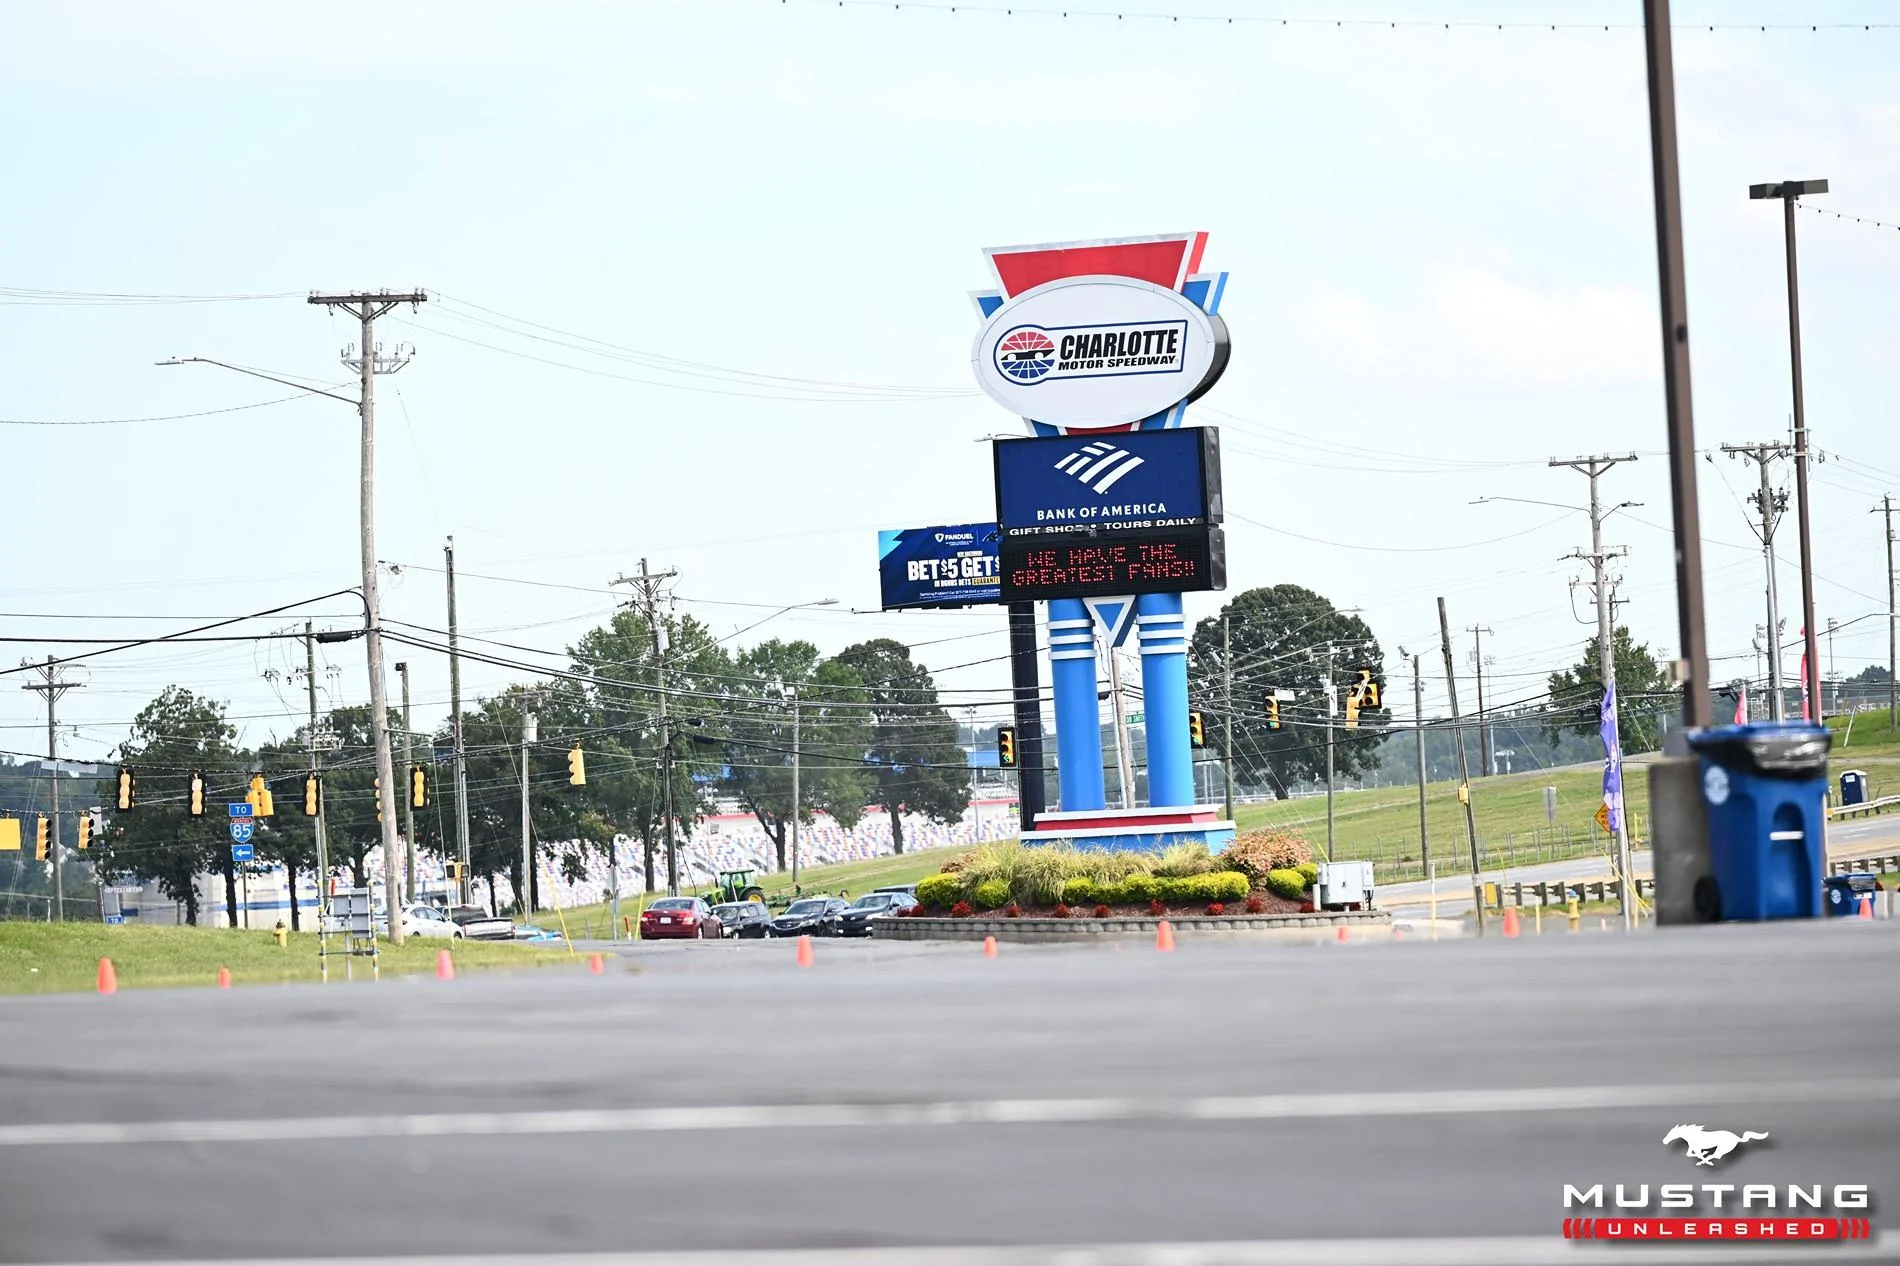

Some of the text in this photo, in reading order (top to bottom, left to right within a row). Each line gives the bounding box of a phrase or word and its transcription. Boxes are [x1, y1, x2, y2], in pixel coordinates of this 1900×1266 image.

[1059, 328, 1179, 360] CHARLOTTE
[1058, 355, 1177, 371] MOTOR SPEEDWAY
[1037, 503, 1167, 521] BANK OF AMERICA
[1009, 526, 1044, 536] GIFT
[1104, 520, 1152, 530] TOURS
[1156, 517, 1196, 527] DAILY
[945, 533, 974, 541] FANDUEL
[1027, 543, 1177, 567] WE HAVE THE
[907, 558, 940, 581] BET
[941, 558, 959, 579] $5
[961, 555, 994, 577] GET
[1012, 560, 1195, 586] GREATEST FANS!!
[235, 806, 247, 814] TO
[233, 824, 251, 838] 85
